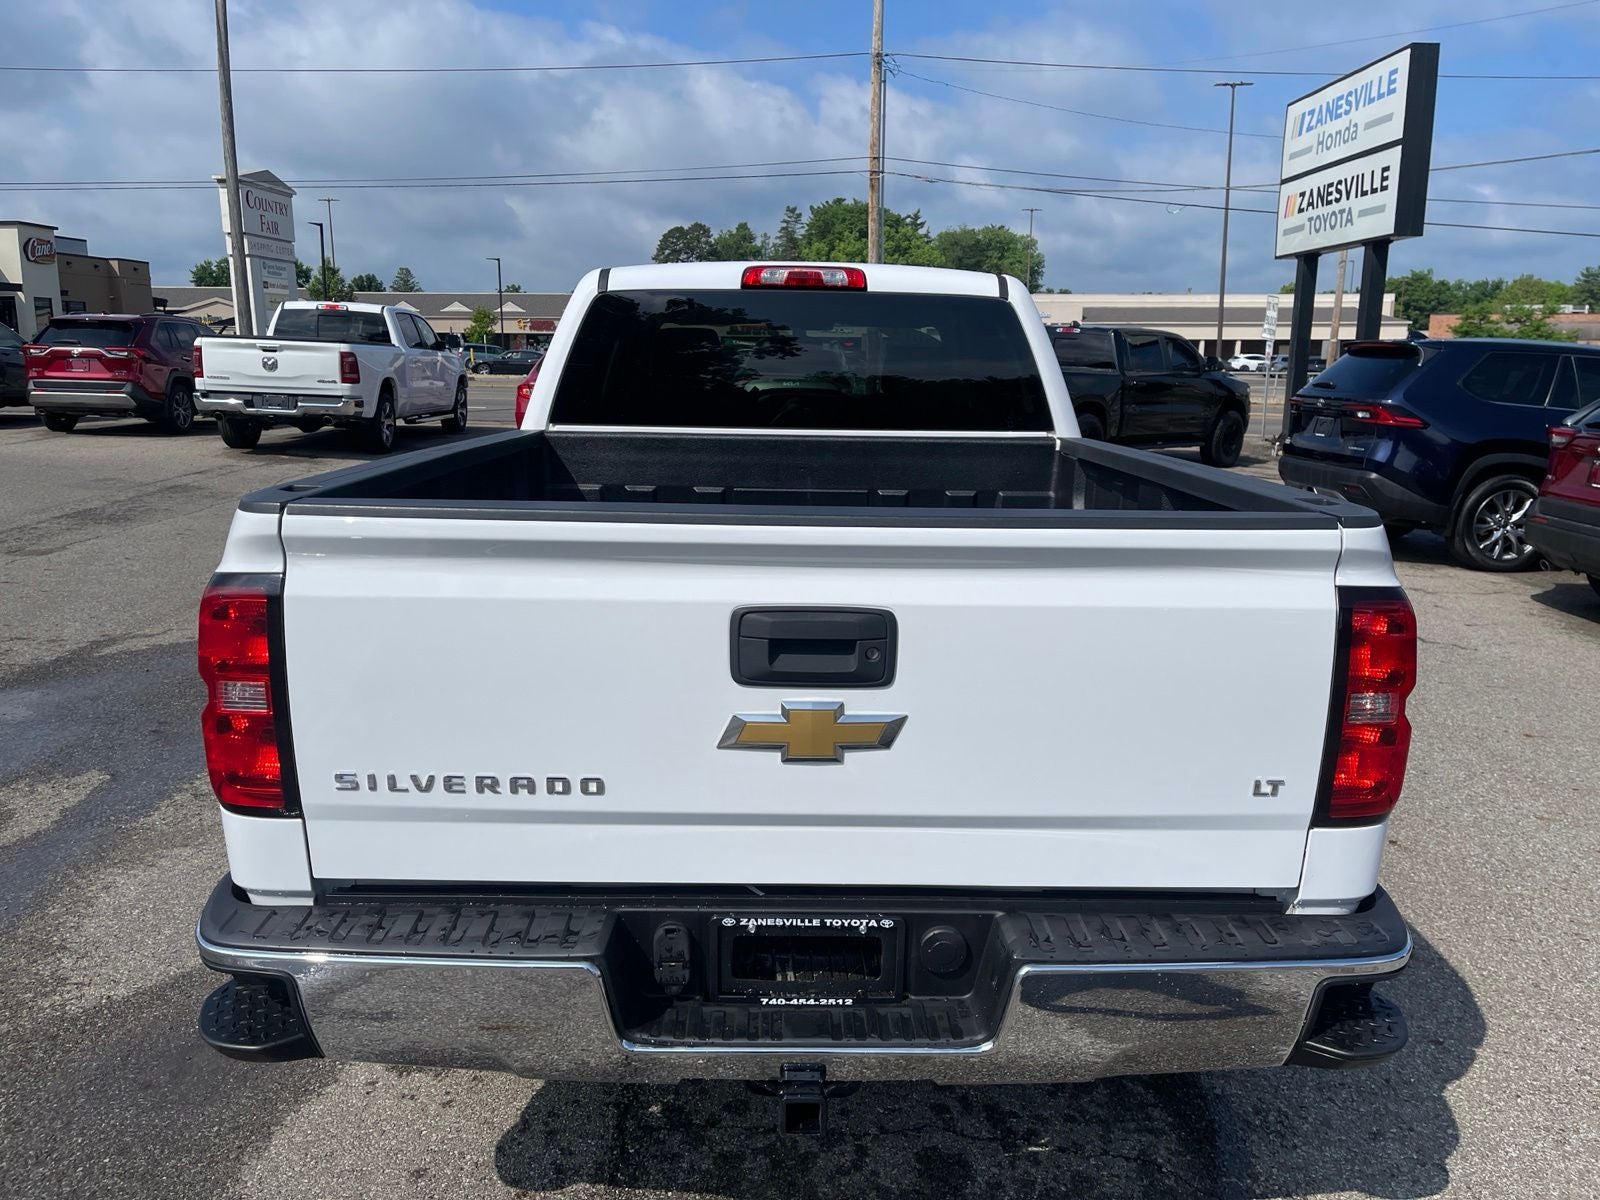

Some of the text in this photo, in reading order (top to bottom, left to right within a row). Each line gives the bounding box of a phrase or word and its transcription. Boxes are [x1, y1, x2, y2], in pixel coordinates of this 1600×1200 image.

[1305, 67, 1399, 133] ZANESVILLE
[1316, 119, 1358, 155] Honda
[1297, 165, 1391, 214] ZANESVILLE
[245, 189, 289, 217] COUNTRY
[260, 214, 280, 236] FAIR
[1307, 207, 1354, 235] TOYOTA
[334, 773, 606, 796] SILVERADO
[1253, 779, 1286, 797] LT
[739, 918, 878, 928] ZANESVILLE TOYOTA
[760, 998, 853, 1006] 740-454-2512
